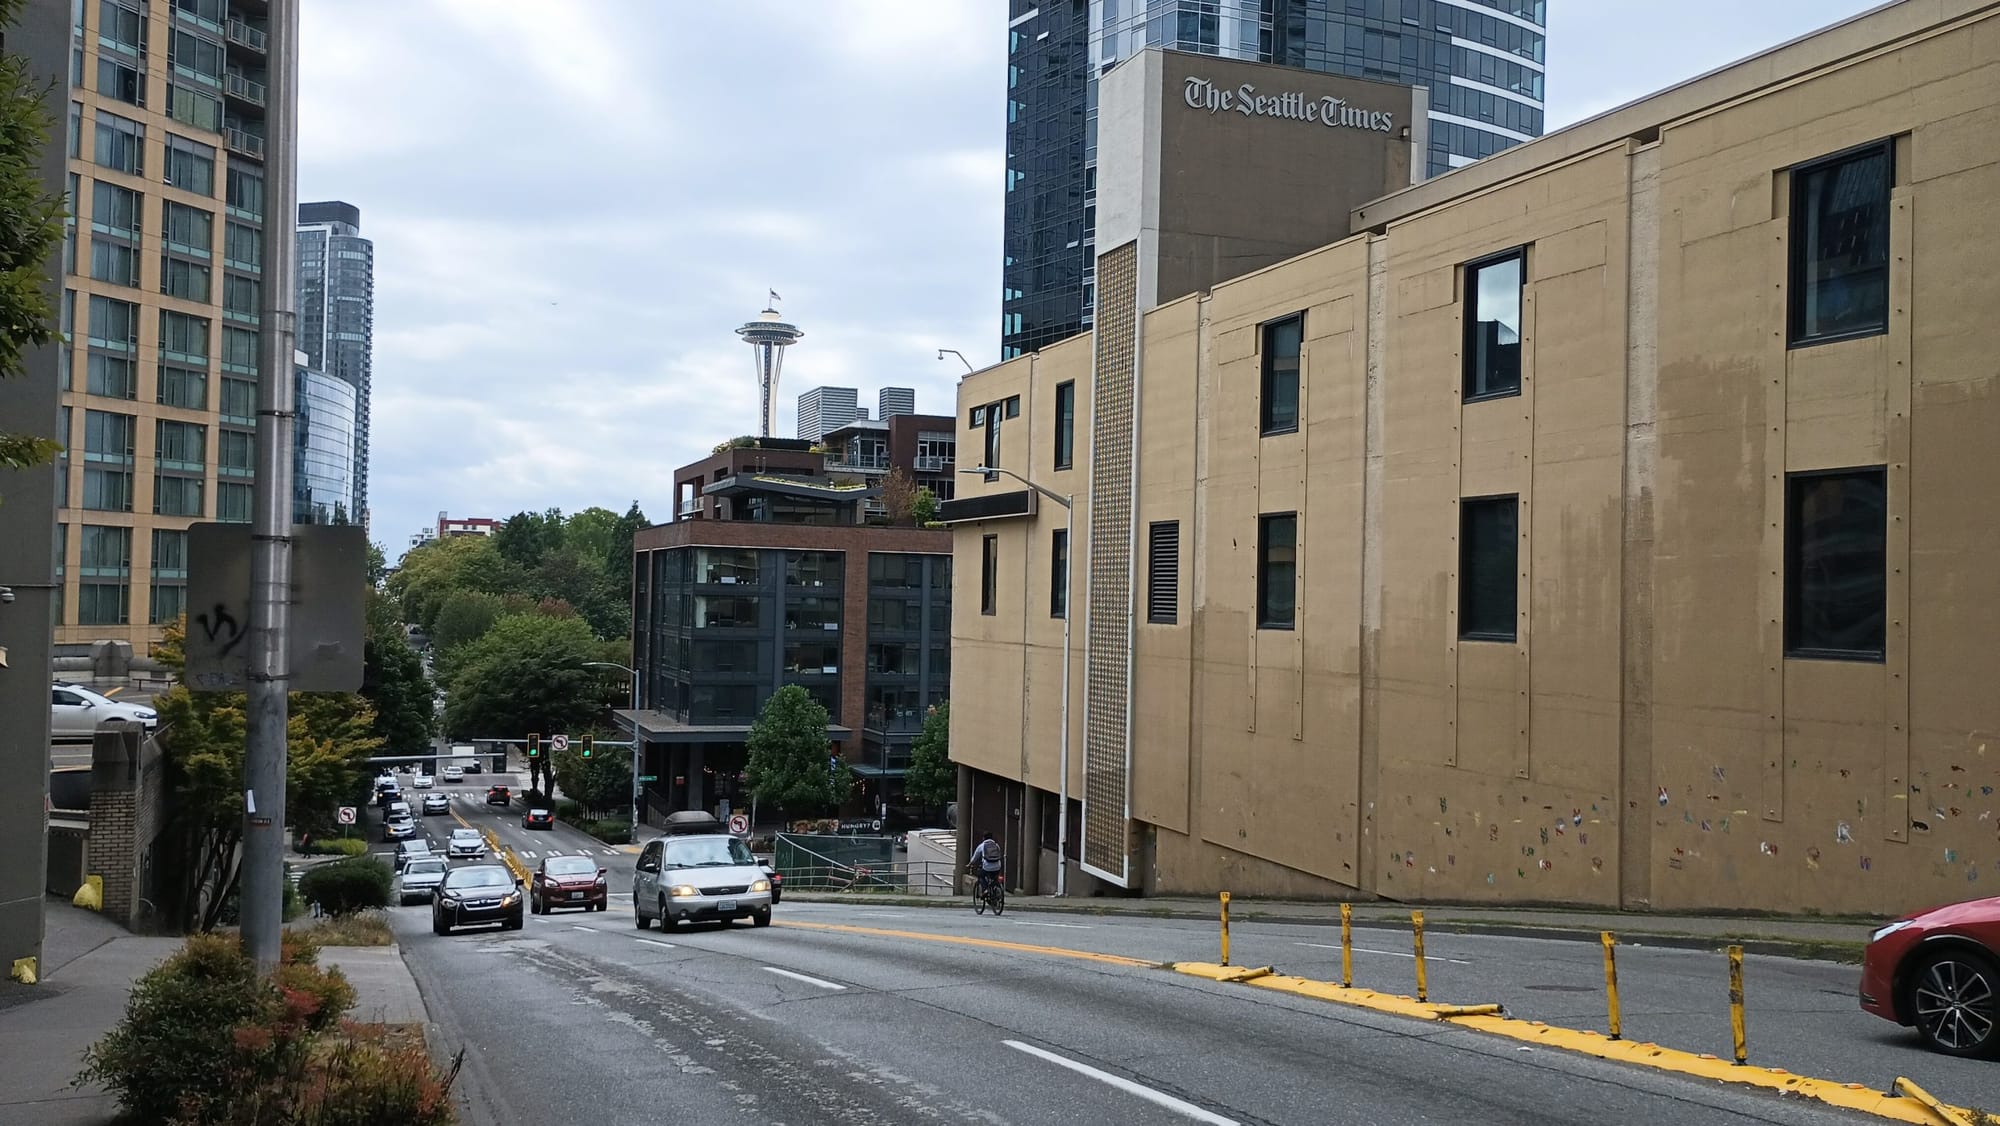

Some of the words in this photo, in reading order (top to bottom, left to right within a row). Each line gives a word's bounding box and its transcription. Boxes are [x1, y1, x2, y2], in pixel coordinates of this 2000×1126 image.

[1184, 76, 1233, 114] The
[1236, 83, 1318, 122] Seattle
[1320, 95, 1393, 132] Times
